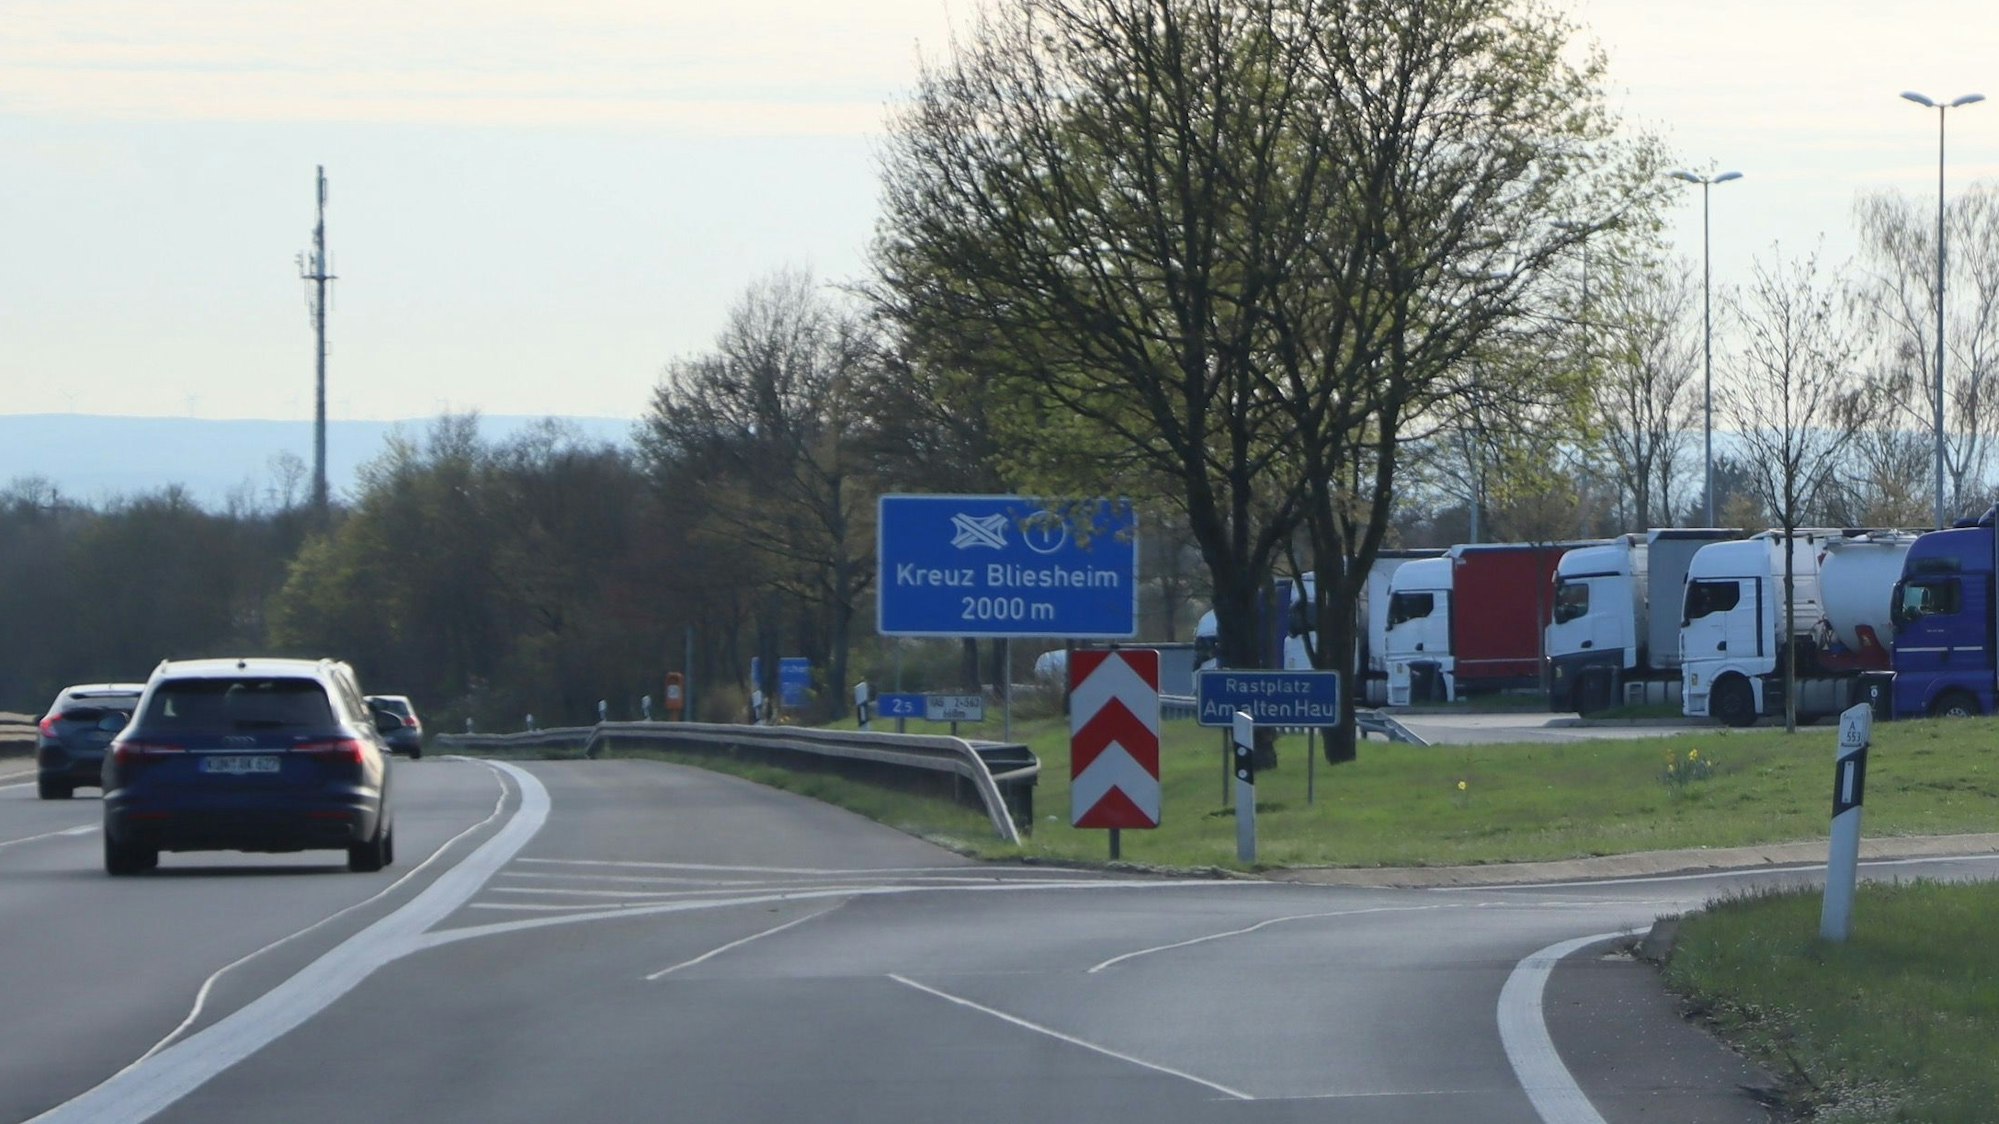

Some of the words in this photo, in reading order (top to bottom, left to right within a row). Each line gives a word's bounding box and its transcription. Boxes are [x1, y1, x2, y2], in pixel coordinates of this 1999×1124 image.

[897, 563, 975, 586] Kreuz
[987, 563, 1118, 587] Bliesheim
[961, 597, 1024, 620] 2000
[1031, 602, 1055, 619] m
[1226, 678, 1311, 696] Rastplatz
[1204, 699, 1236, 716] Am
[1241, 699, 1291, 717] alten
[1295, 699, 1334, 717] Hau
[1849, 720, 1856, 730] A
